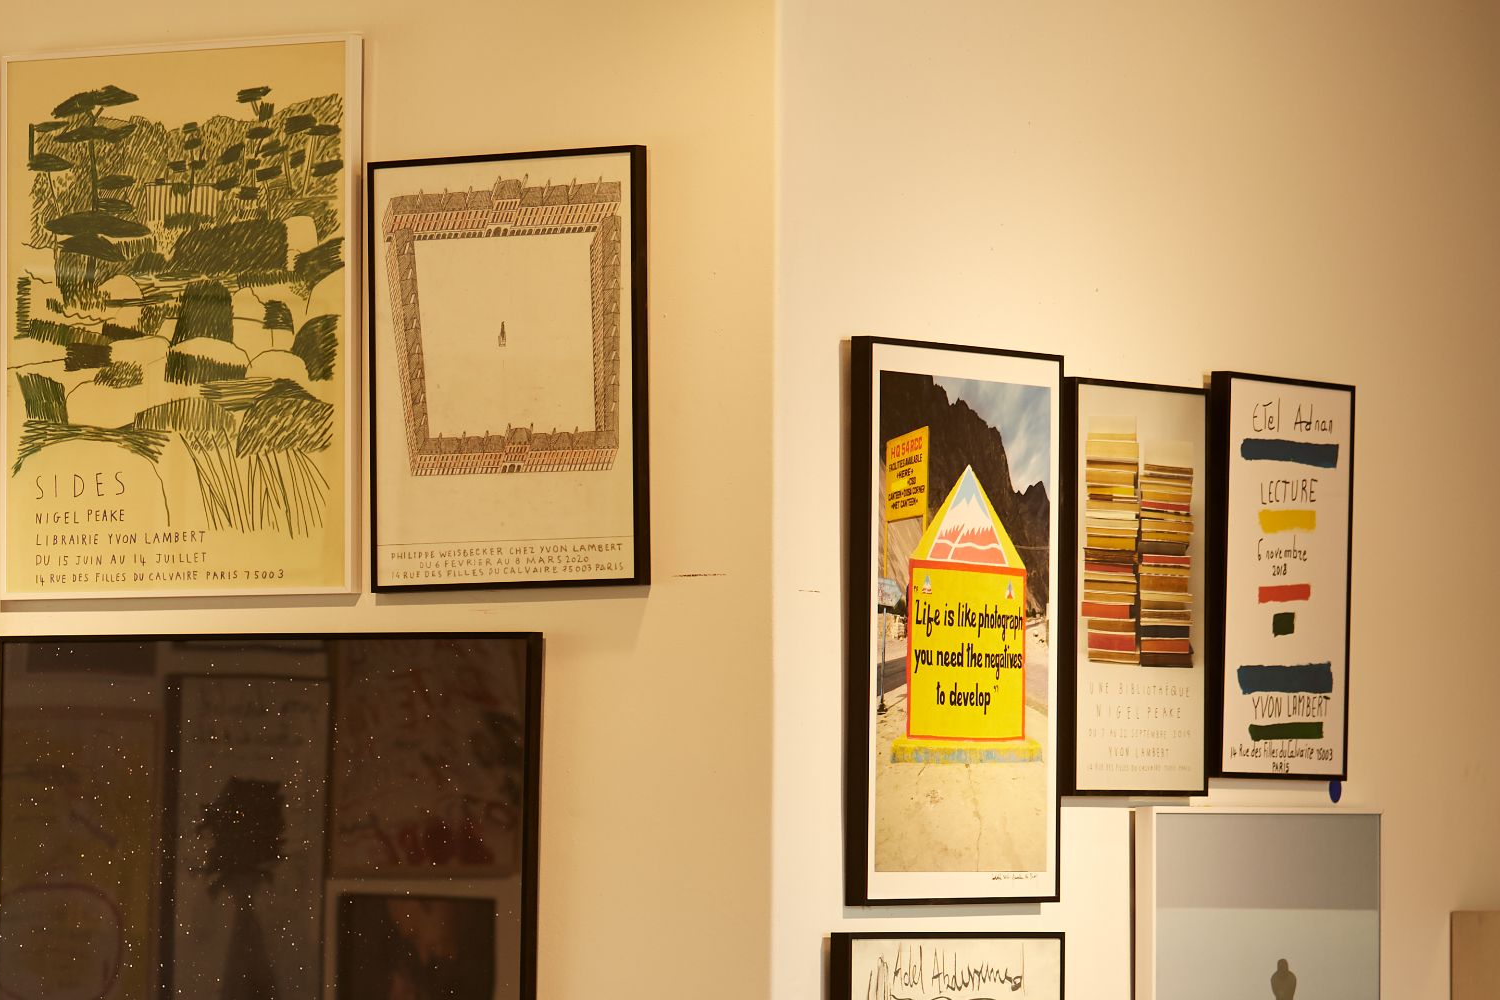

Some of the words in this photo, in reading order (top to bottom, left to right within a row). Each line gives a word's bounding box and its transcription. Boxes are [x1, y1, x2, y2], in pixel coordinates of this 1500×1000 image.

[36, 471, 125, 499] SIDES
[1261, 478, 1318, 505] LECTURE
[36, 511, 79, 524] NIGEL
[87, 509, 125, 522] PEAKE
[36, 533, 99, 546] LIBRAIRIE
[108, 533, 137, 545] YVON
[145, 531, 205, 544] LAMBERT
[509, 546, 535, 555] CHEZ
[540, 544, 568, 553] YVON
[573, 543, 623, 552] LAMBERT
[1257, 538, 1263, 561] 6
[1265, 535, 1308, 562] novembre
[36, 555, 50, 566] DU
[58, 555, 68, 566] 15
[76, 555, 102, 566] JUIN
[110, 555, 125, 565] AU
[134, 554, 146, 566] 14
[156, 552, 207, 564] JUILLET
[526, 555, 561, 565] MARS
[36, 574, 45, 586] 14
[50, 574, 66, 583] RUE
[72, 573, 88, 583] DES
[95, 572, 126, 583] FILLES
[133, 573, 144, 582] DU
[149, 571, 198, 581] CALVAIRE
[206, 571, 238, 580] PARIS
[244, 569, 284, 579] 75003
[915, 599, 940, 637] Life
[944, 602, 955, 627] is
[957, 602, 976, 628] like
[978, 604, 1022, 641] photograph
[914, 648, 933, 674] you
[937, 642, 964, 667] need
[966, 642, 982, 668] the
[984, 644, 1022, 681] negatives
[936, 681, 945, 705] to
[1252, 695, 1282, 720] YVON
[1288, 694, 1330, 718] LAMBERT
